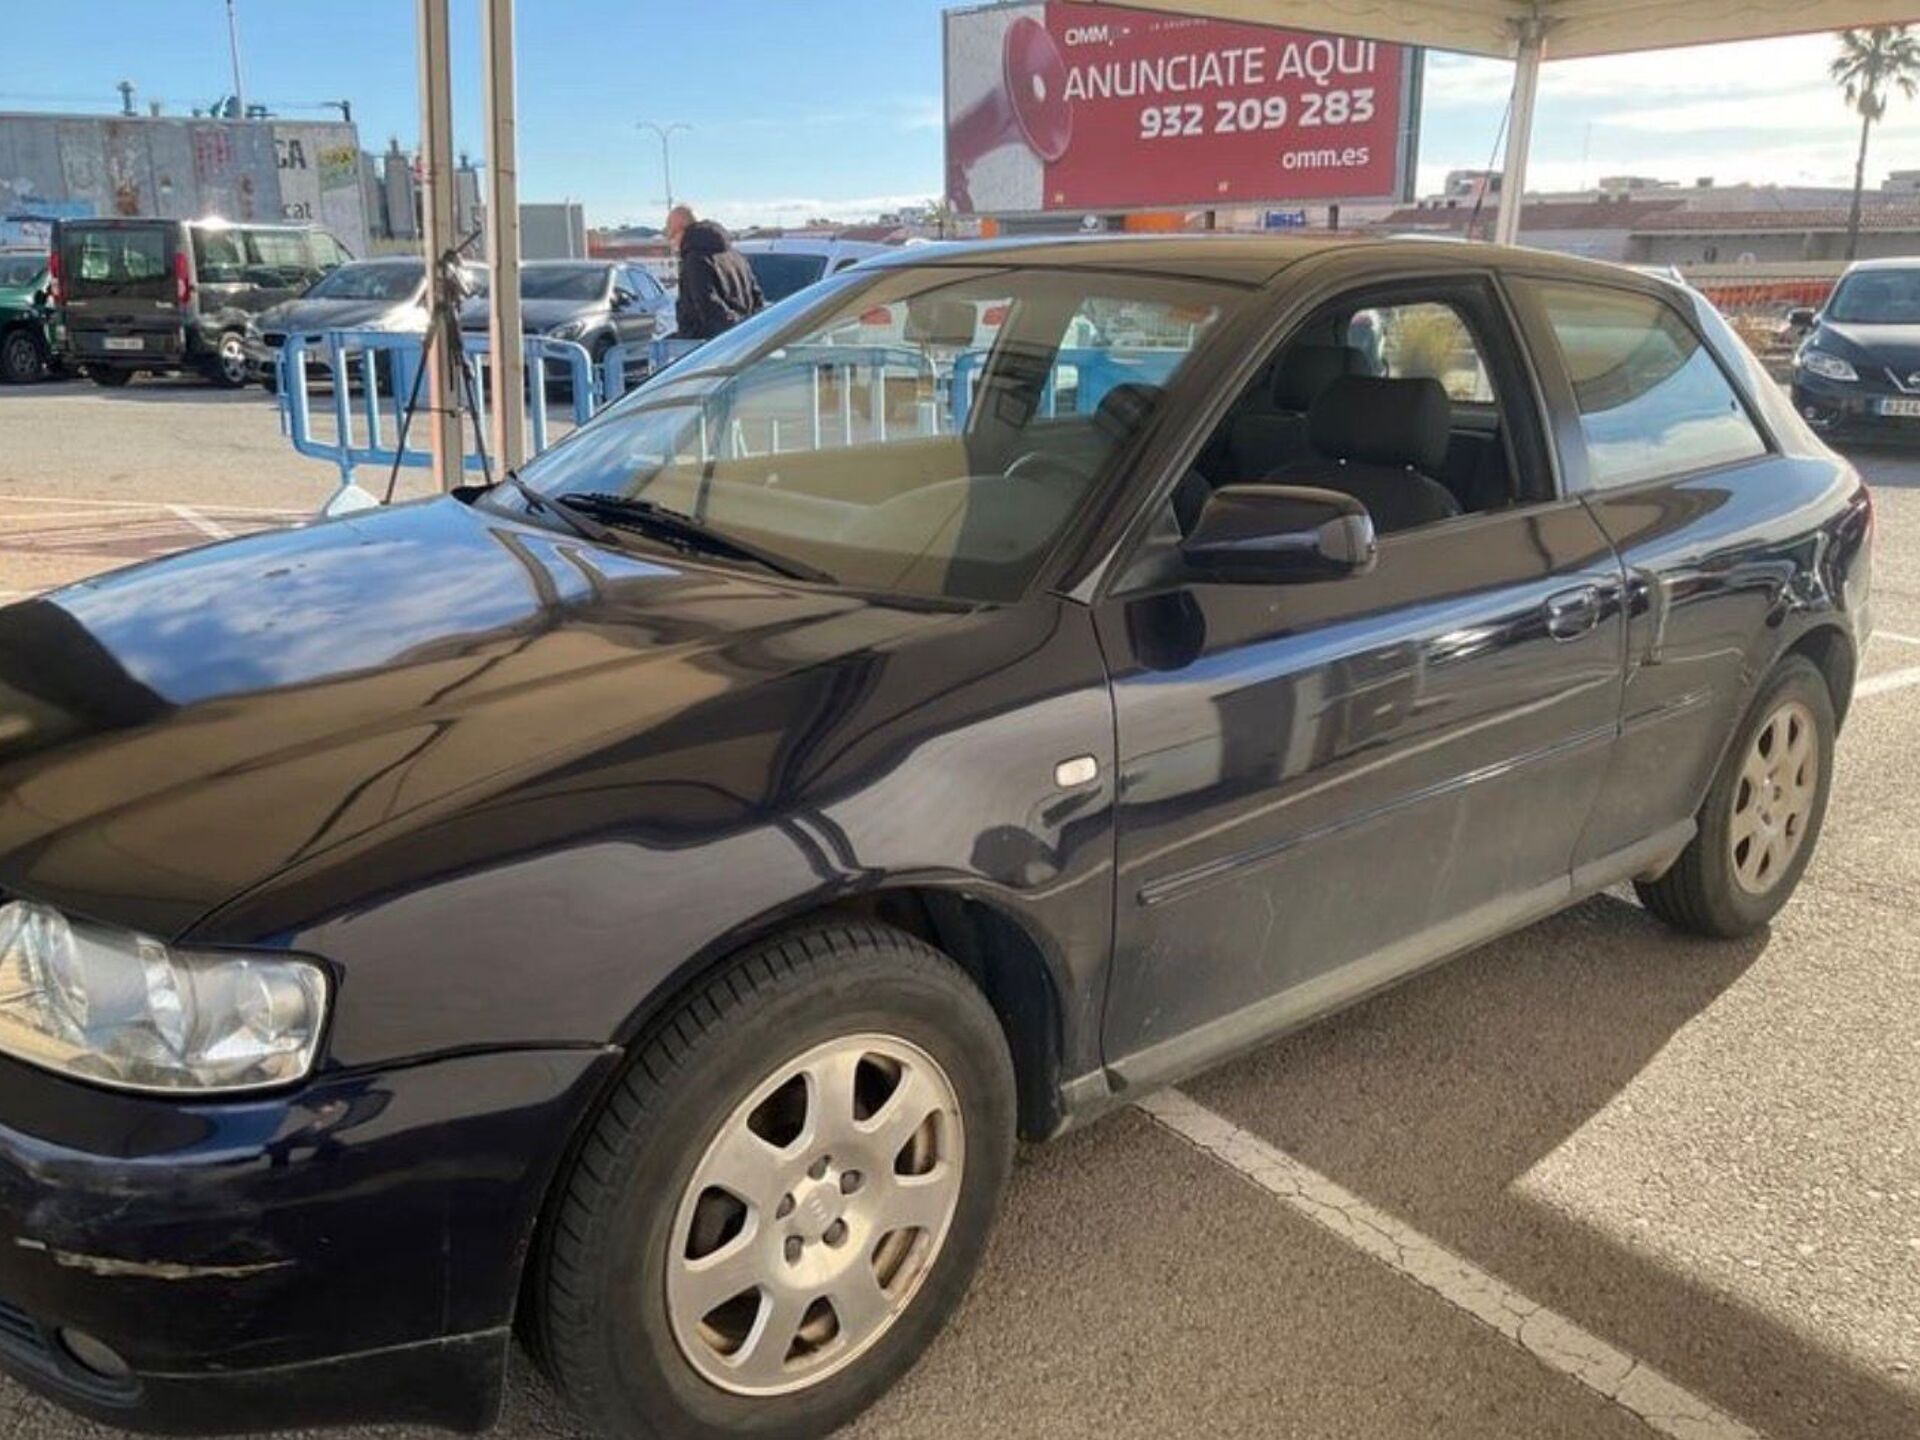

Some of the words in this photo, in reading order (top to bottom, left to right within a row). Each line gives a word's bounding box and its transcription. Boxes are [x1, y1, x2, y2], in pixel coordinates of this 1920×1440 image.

[1063, 47, 1266, 101] ANUNCIATE
[1140, 103, 1204, 139] 932
[1214, 96, 1288, 134] 209
[1298, 87, 1375, 127] 283
[1281, 146, 1370, 169] omm.es
